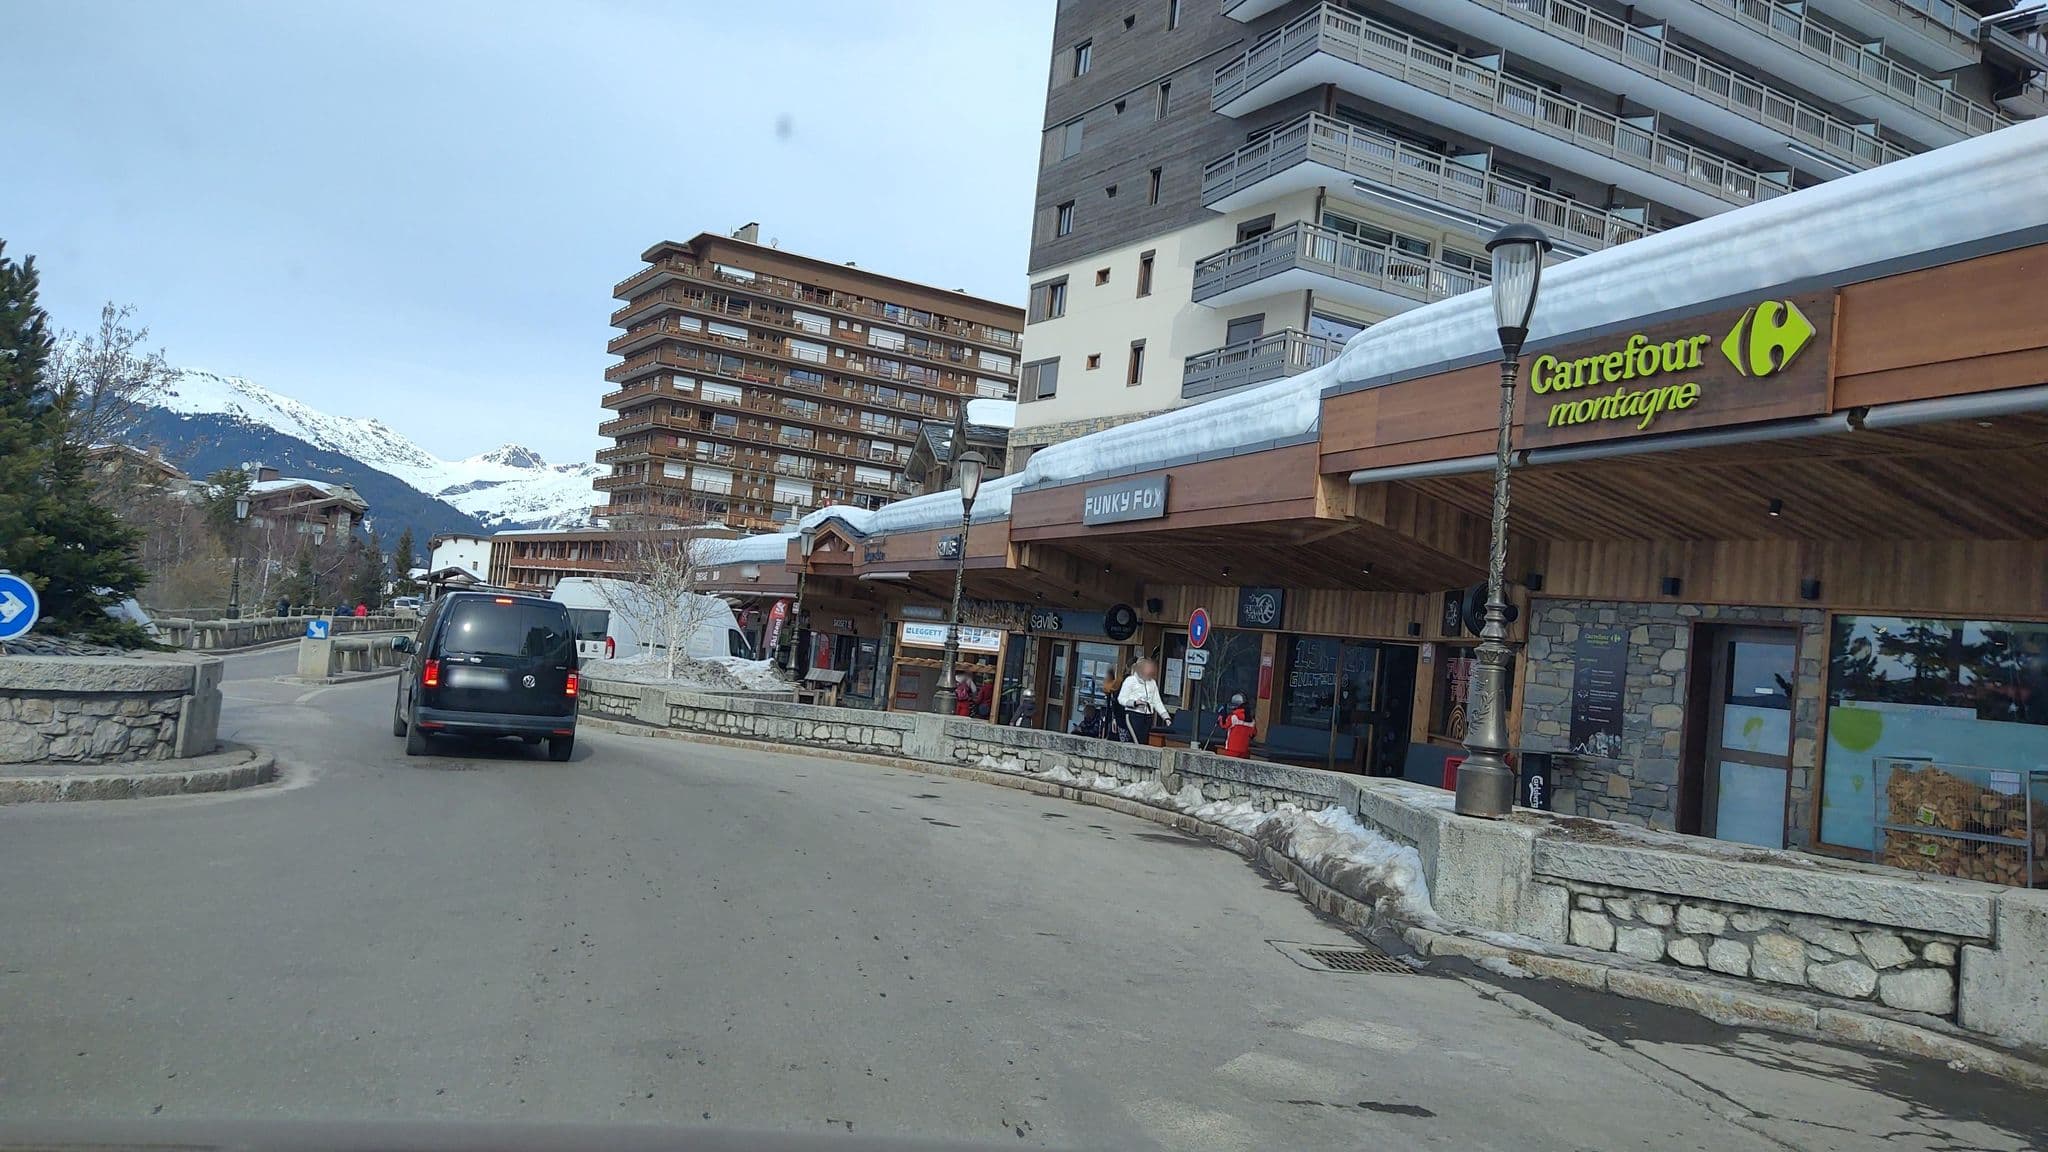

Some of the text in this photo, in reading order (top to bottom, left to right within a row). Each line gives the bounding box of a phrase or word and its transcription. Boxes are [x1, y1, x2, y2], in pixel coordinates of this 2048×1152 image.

[1531, 333, 1711, 395] Carrefour
[1547, 382, 1700, 430] montagne
[1085, 487, 1161, 517] FUNKY FOX
[911, 627, 943, 637] LEGGETT
